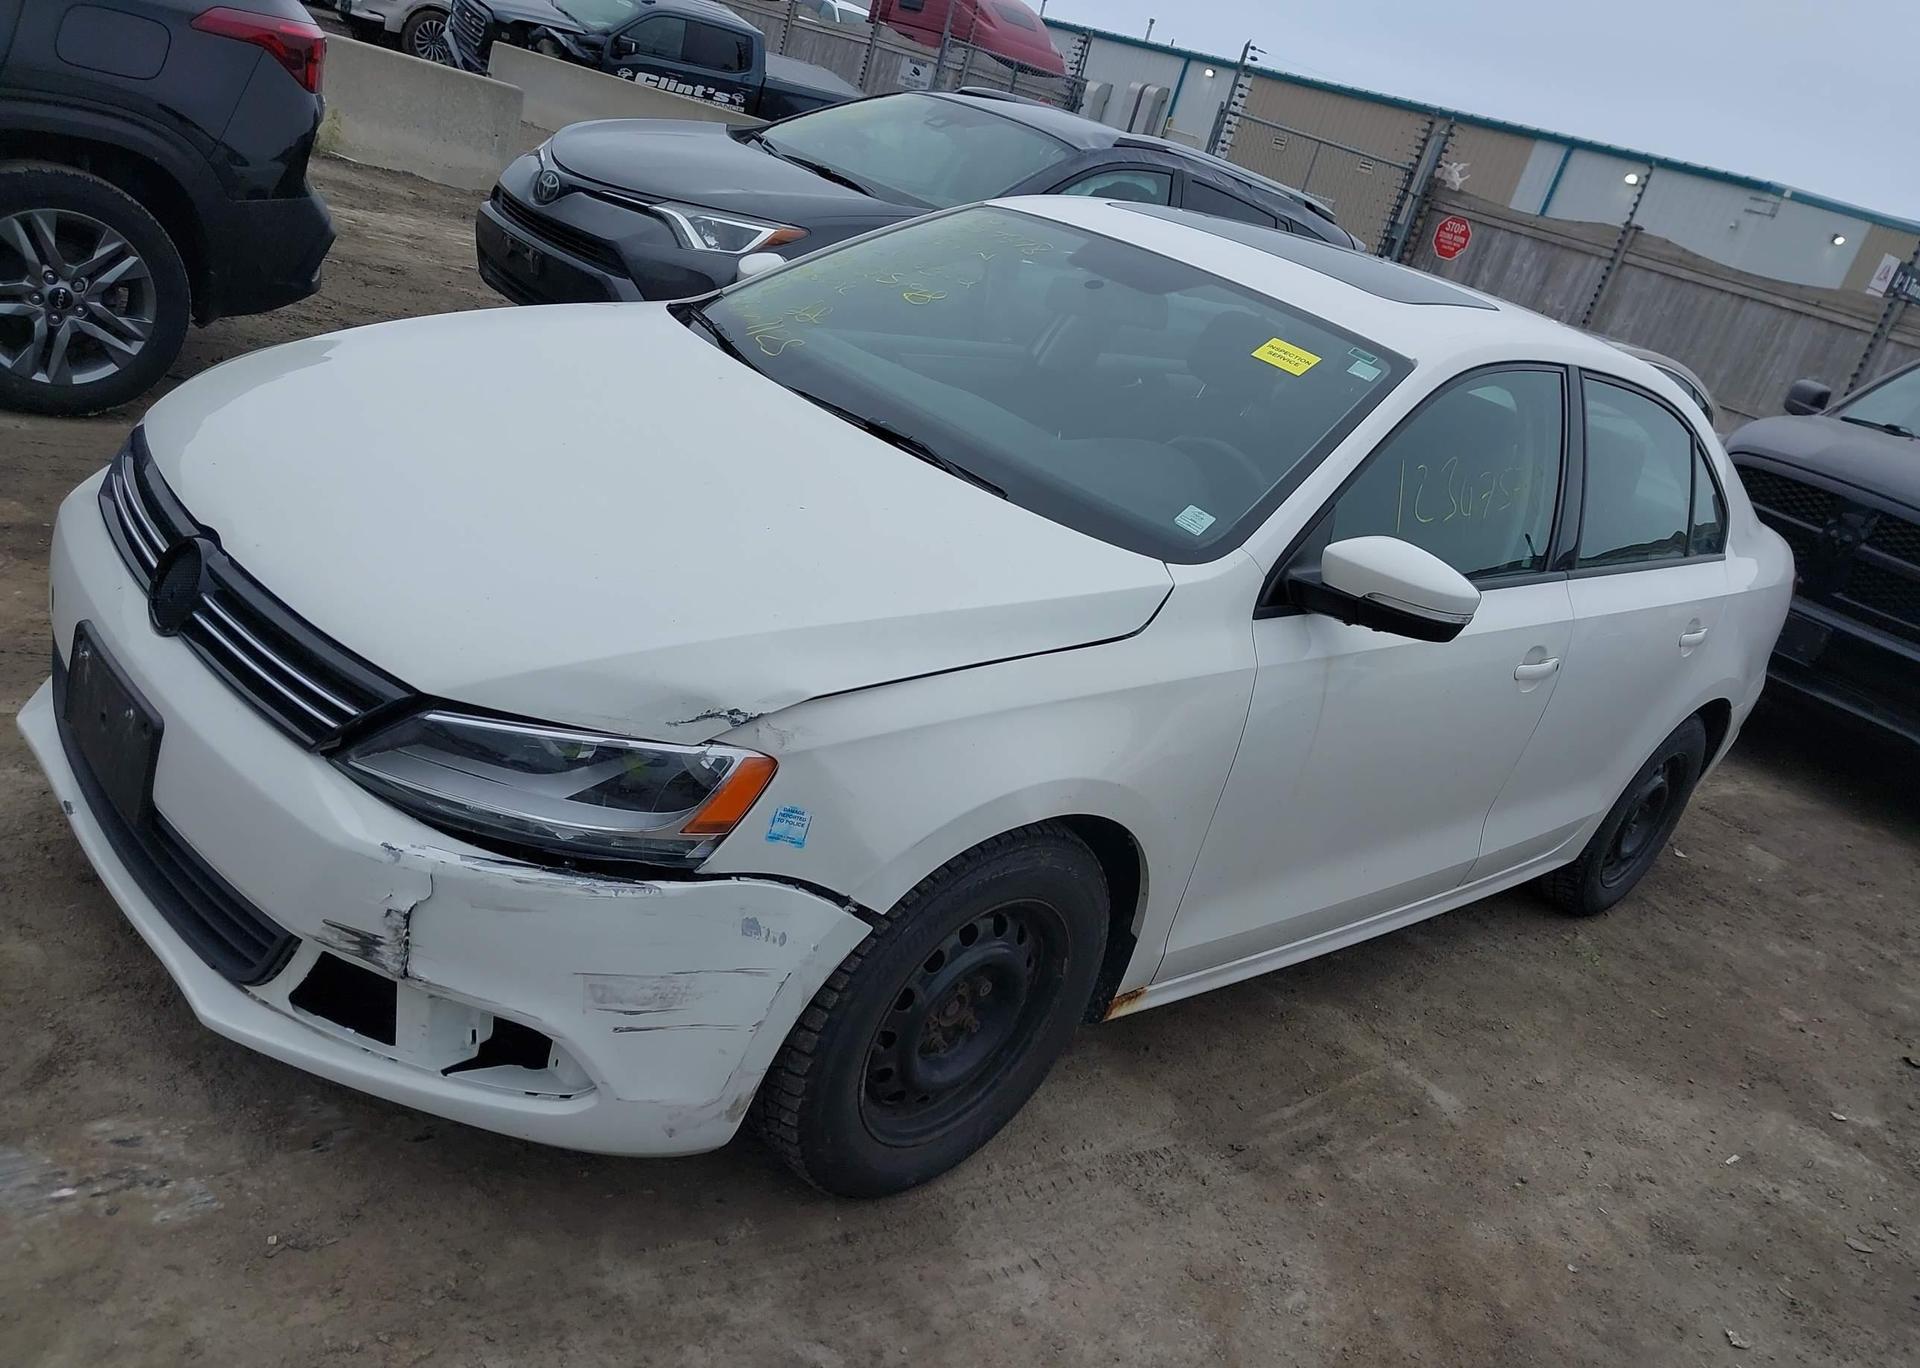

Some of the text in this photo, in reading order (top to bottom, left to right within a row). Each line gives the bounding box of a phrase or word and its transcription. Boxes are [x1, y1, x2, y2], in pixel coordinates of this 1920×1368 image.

[634, 71, 732, 103] Clint's
[1445, 221, 1466, 234] STOP
[1266, 343, 1312, 366] INSPECTION
[1267, 350, 1301, 368] SERVICE
[778, 812, 807, 822] REPORTED
[783, 807, 806, 816] DAMAGE
[785, 819, 806, 828] POLICE
